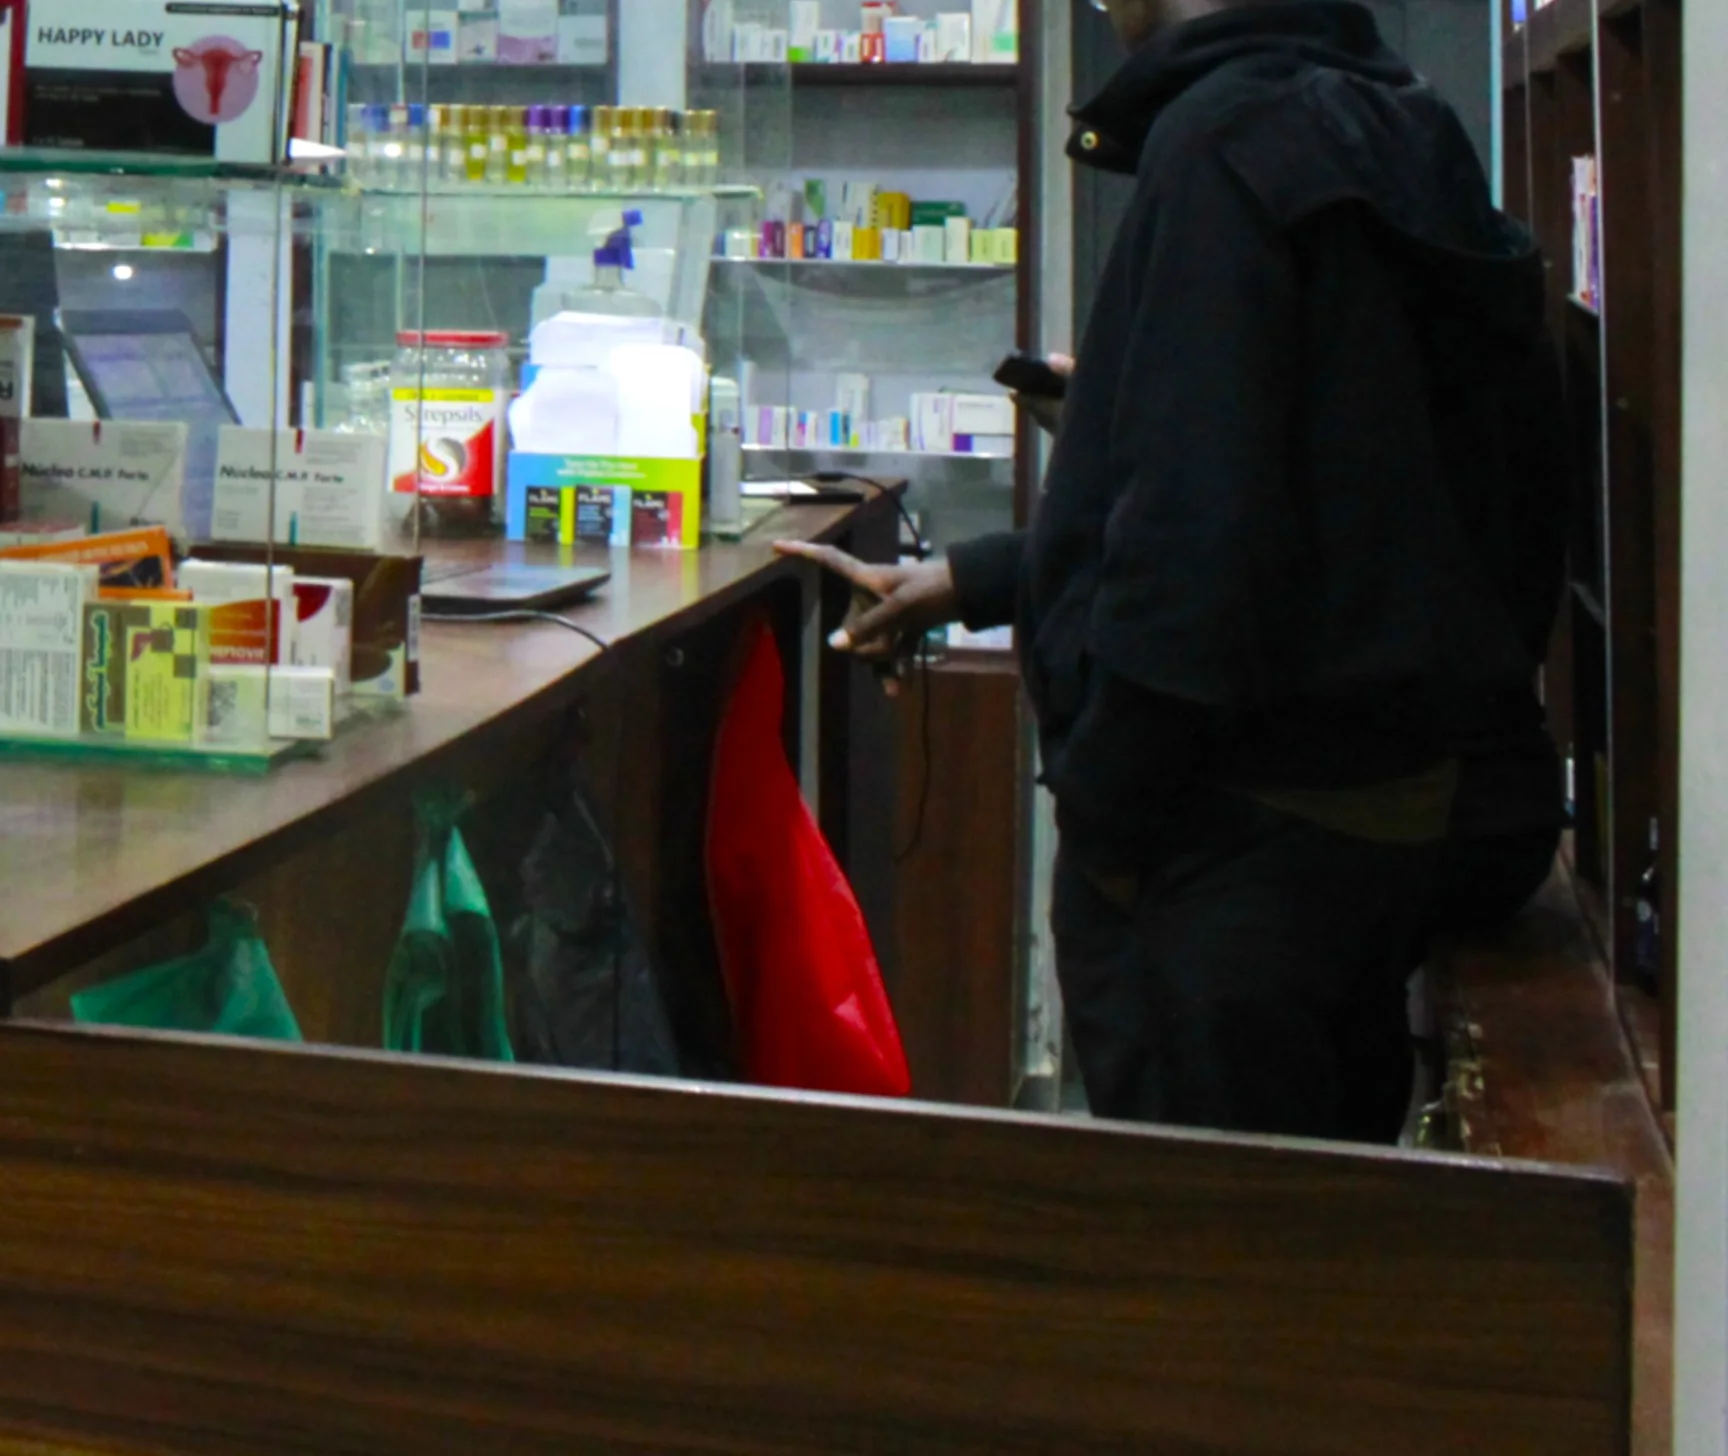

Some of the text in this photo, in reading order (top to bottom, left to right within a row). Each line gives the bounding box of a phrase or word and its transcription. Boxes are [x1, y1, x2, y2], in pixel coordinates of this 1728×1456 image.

[38, 27, 164, 48] HAPPY LADY
[404, 406, 483, 425] Srepsils
